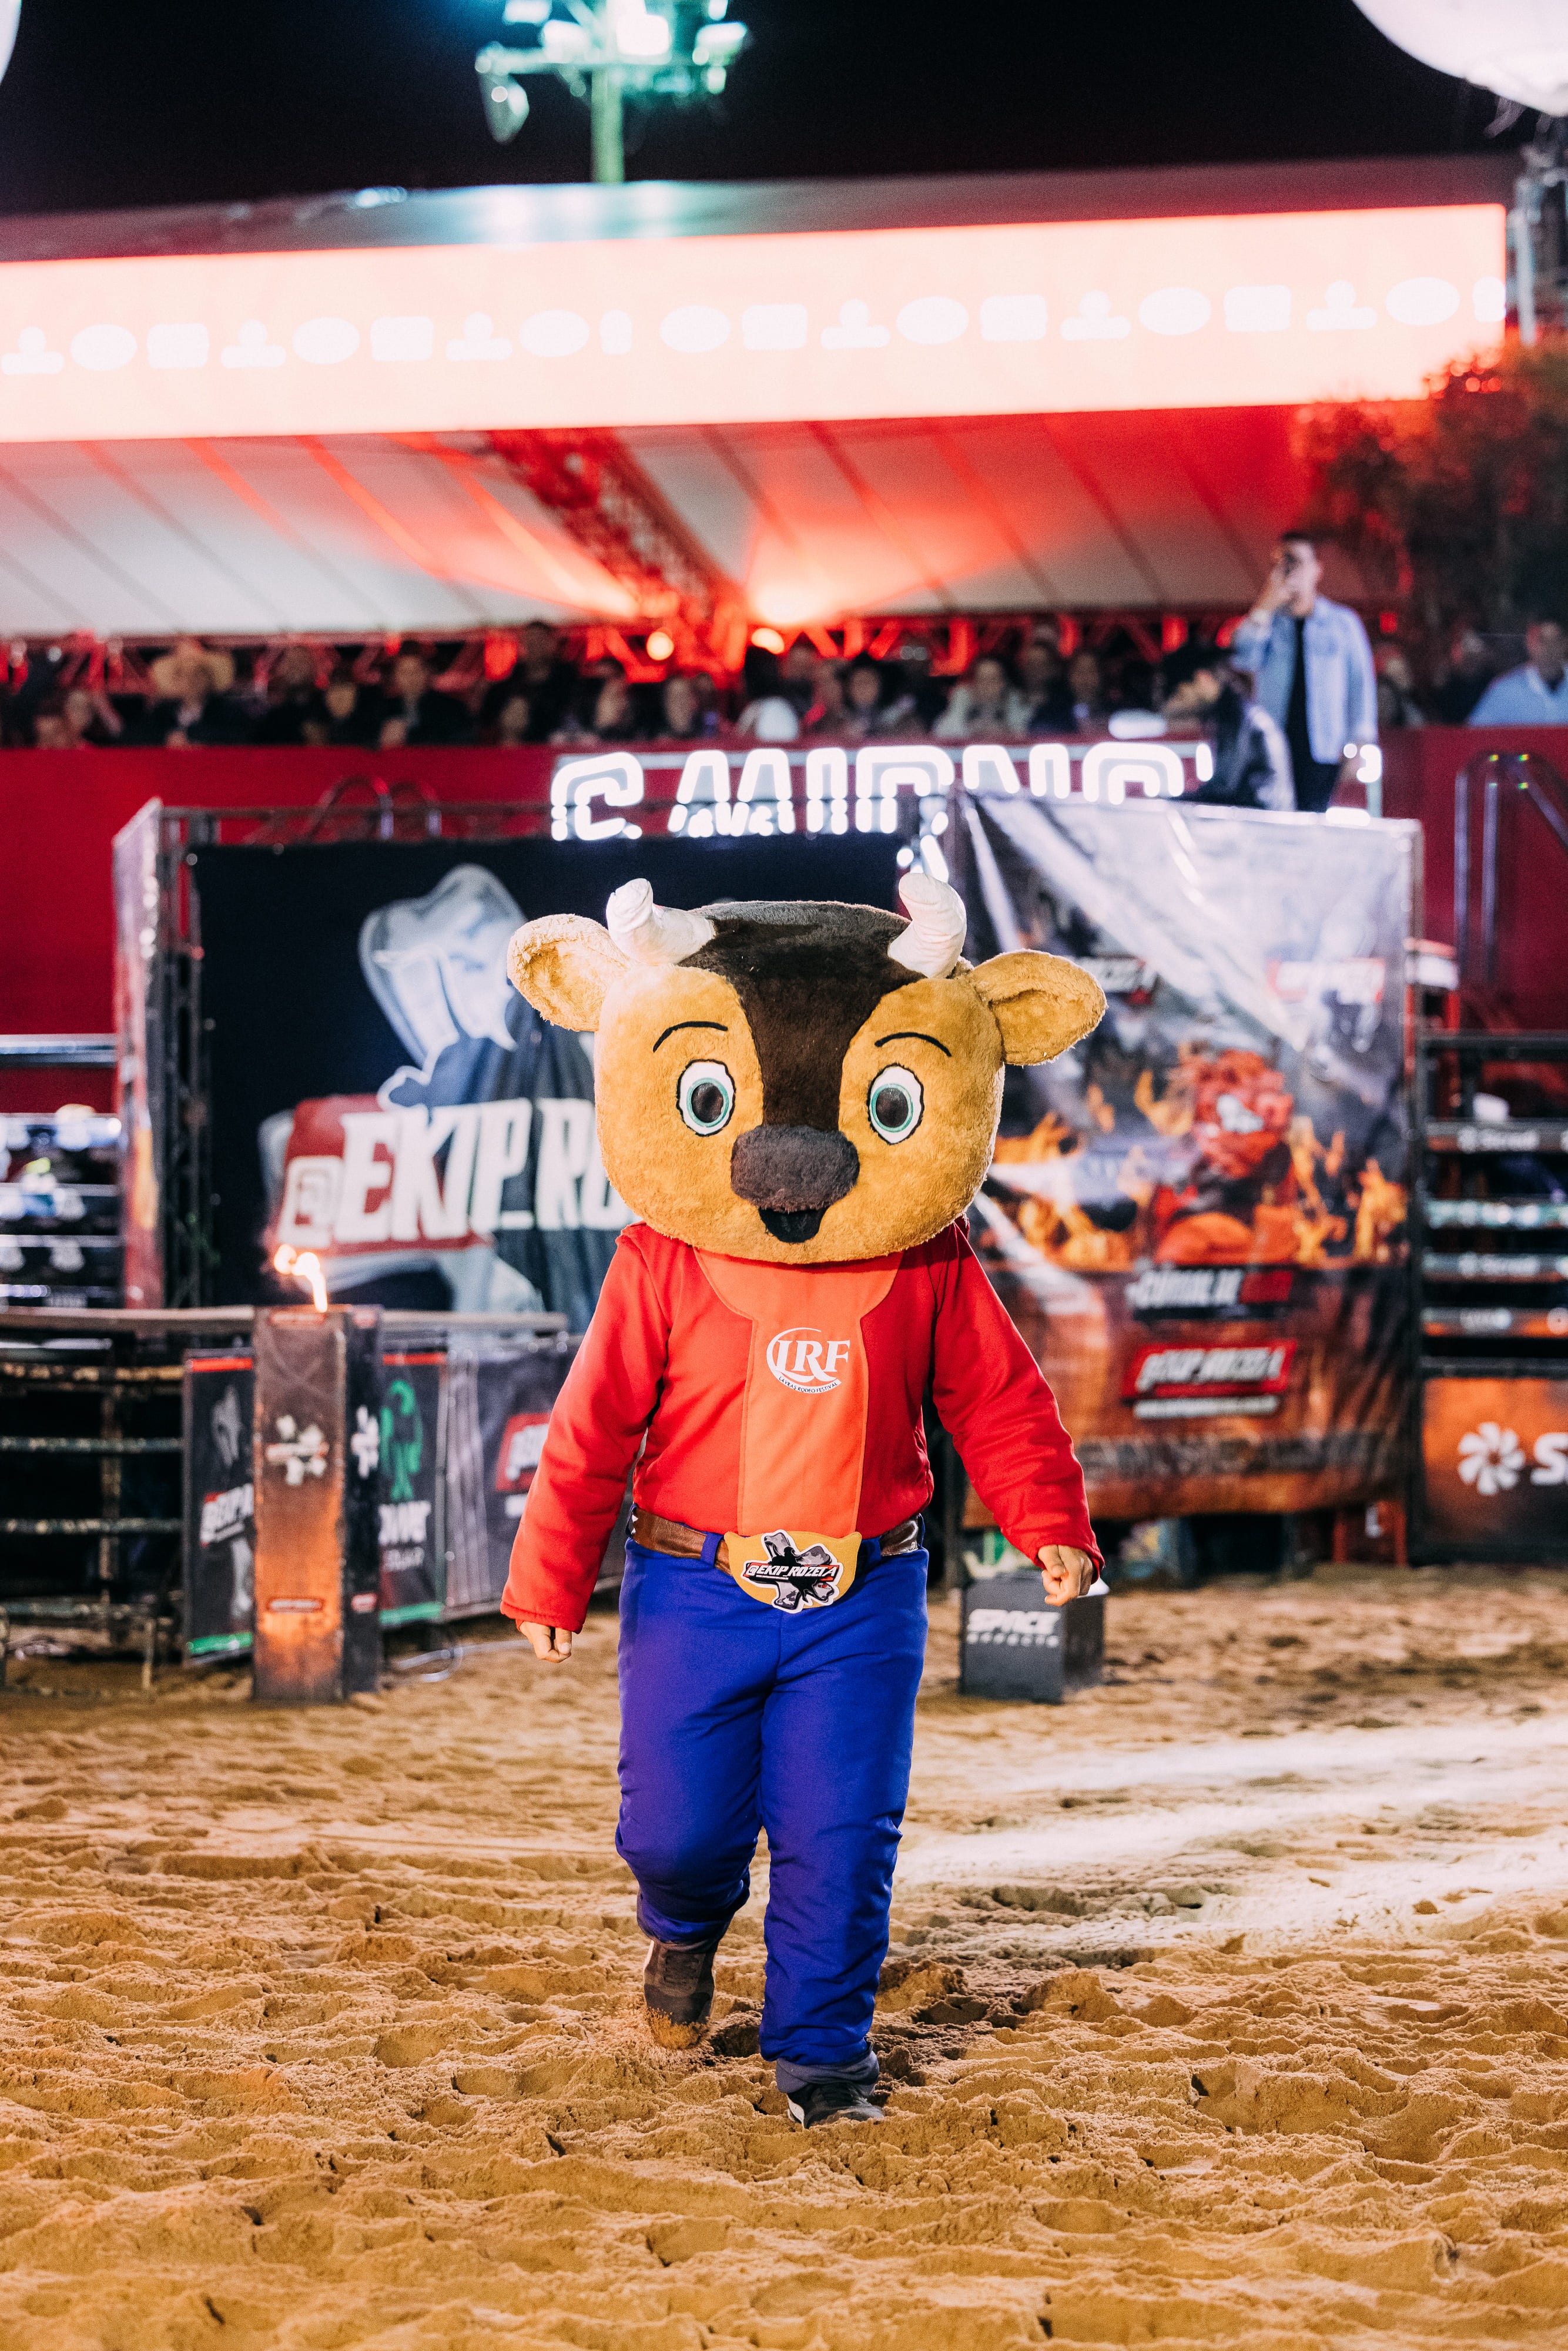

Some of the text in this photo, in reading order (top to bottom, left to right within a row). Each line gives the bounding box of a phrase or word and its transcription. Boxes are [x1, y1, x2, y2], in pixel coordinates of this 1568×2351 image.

[279, 1097, 644, 1247] @EKIP_RO
[772, 1339, 850, 1383] LRF
[779, 1376, 797, 1391] LAVRAS
[816, 1381, 838, 1393] FESTIVAL
[1530, 1431, 1568, 1485] S
